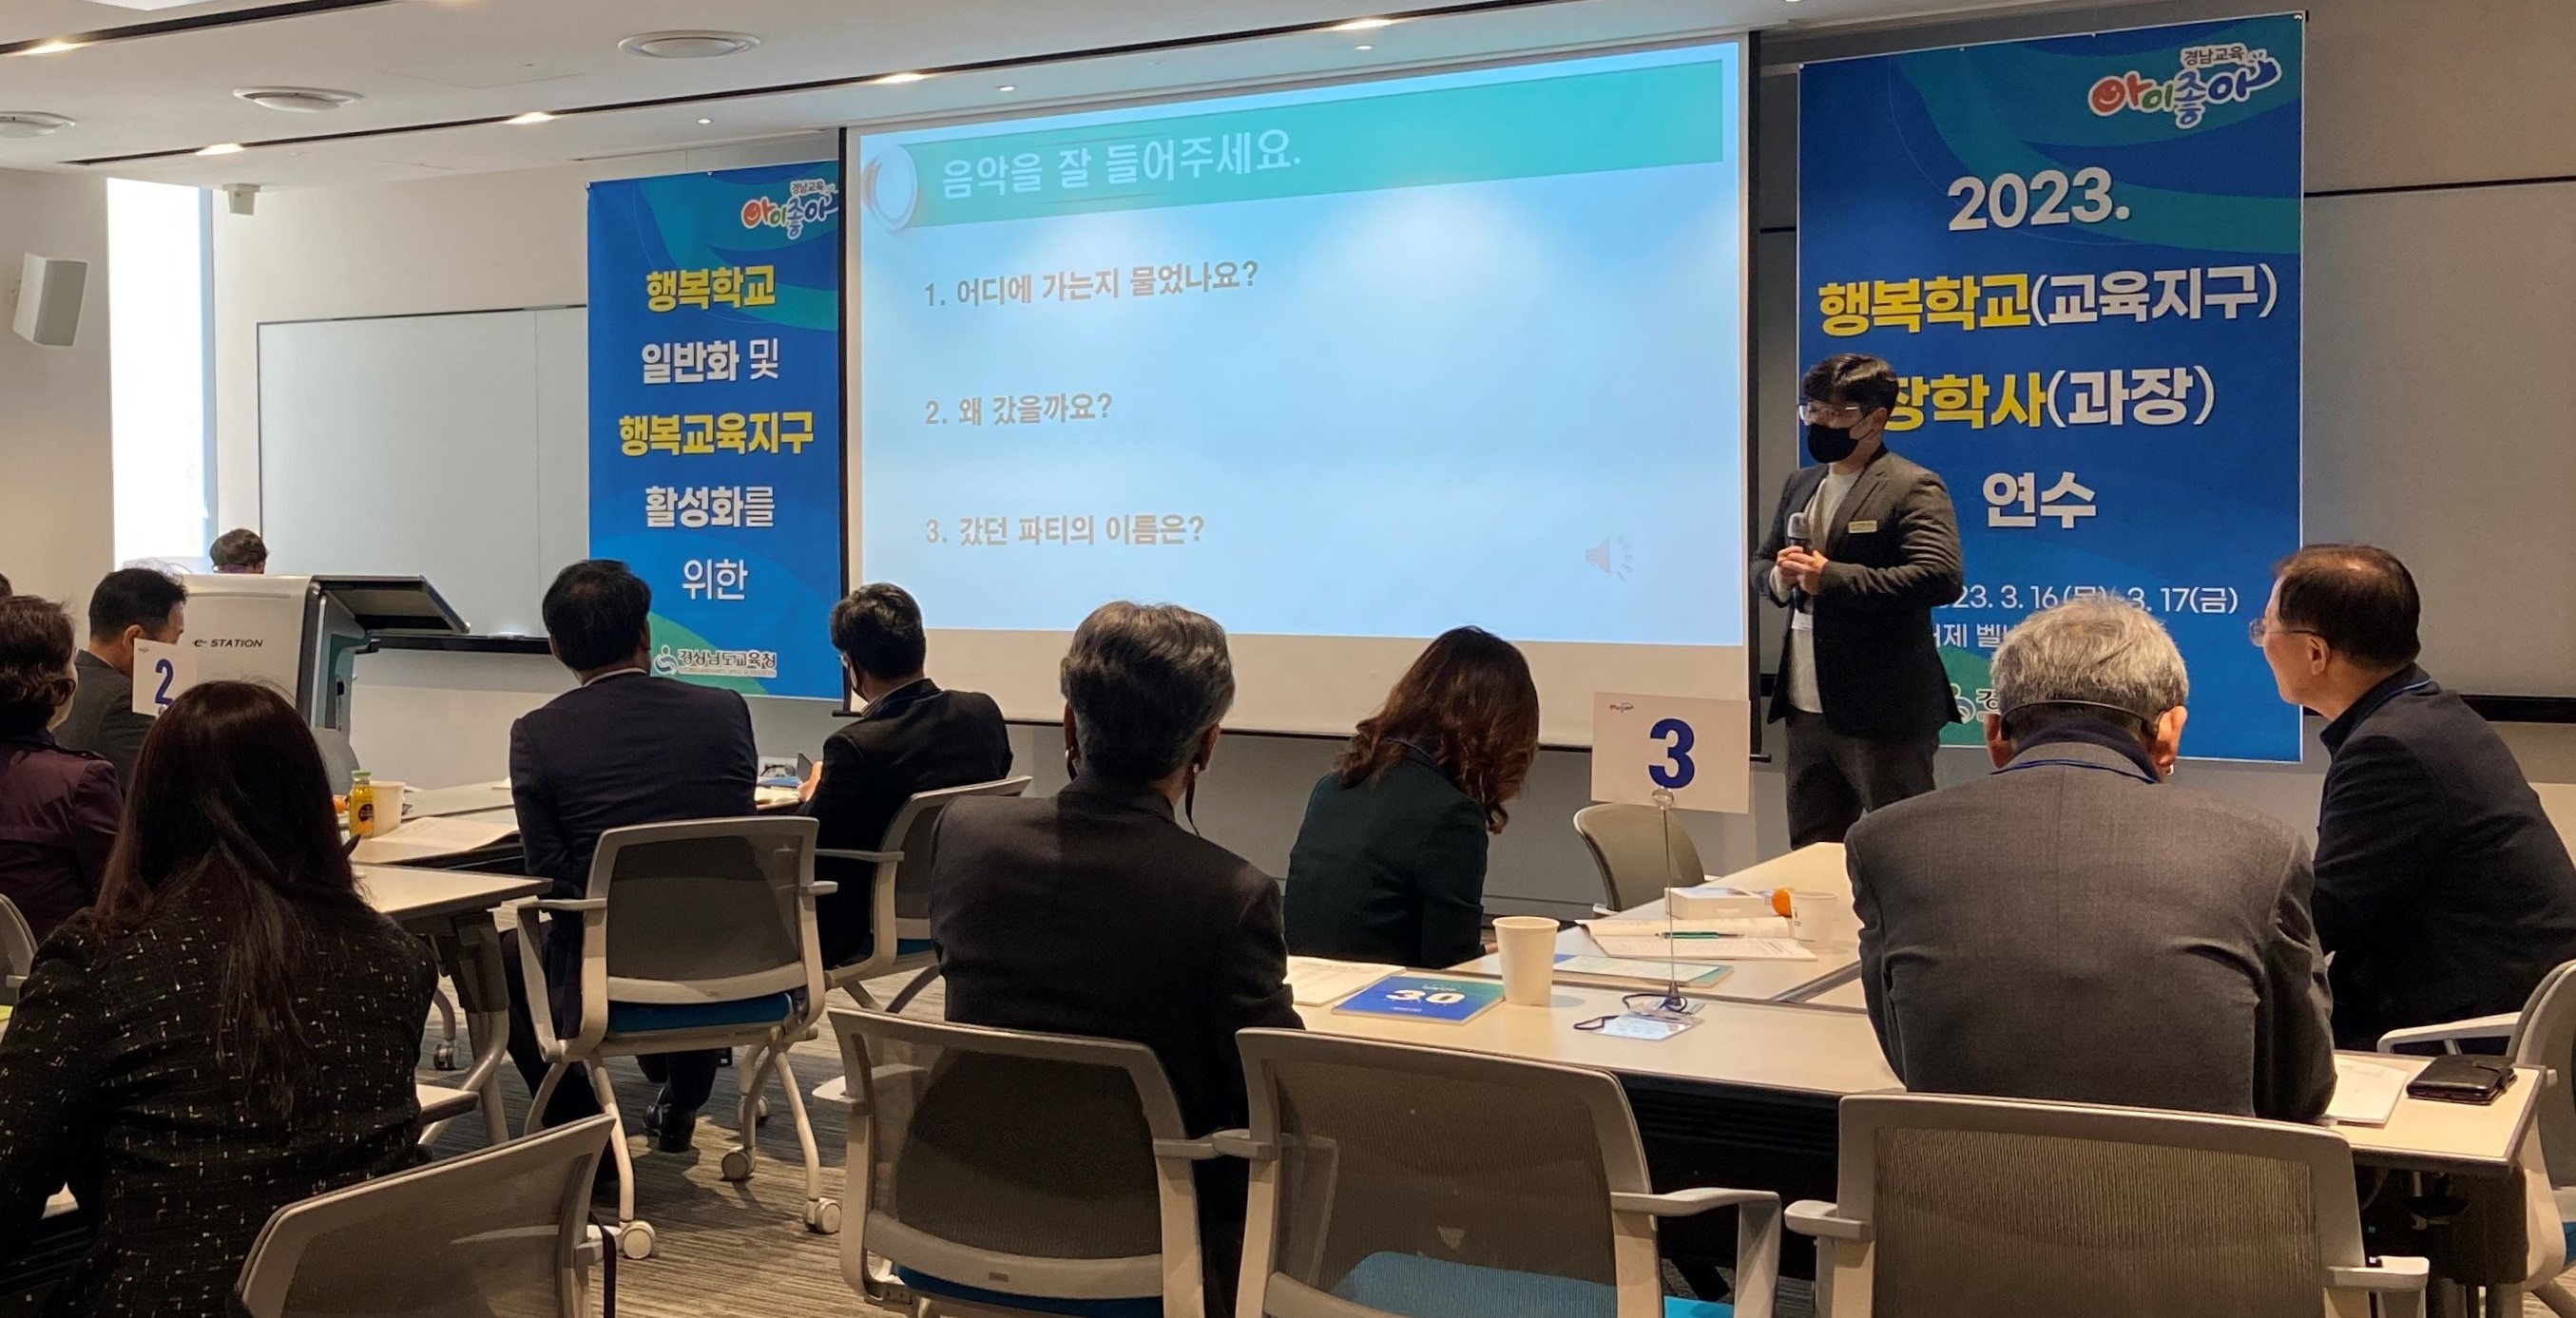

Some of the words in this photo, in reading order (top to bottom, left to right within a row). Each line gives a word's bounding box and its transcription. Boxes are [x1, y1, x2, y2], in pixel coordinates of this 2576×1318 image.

[2183, 46, 2245, 67] 경남교육
[2090, 61, 2278, 126] 아이좋아
[942, 151, 1042, 200] 음악을
[1058, 147, 1091, 189] 잘
[1105, 127, 1301, 185] 들어주세요.
[792, 180, 824, 195] 경남교육
[1947, 166, 2130, 231] 2023.
[646, 265, 776, 312] 행복학교
[925, 282, 947, 307] 1.
[957, 276, 1032, 307] 어디에
[1043, 267, 1120, 301] 가는지
[1130, 260, 1259, 296] 물었나요?
[1817, 264, 2278, 337] 행복학교(교육지구)
[642, 339, 740, 384] 일반화
[749, 338, 779, 380] 및
[925, 400, 948, 425] 2.
[958, 396, 983, 426] 왜
[992, 392, 1113, 426] 갔을까요?
[619, 411, 813, 456] 행복교육지구
[644, 486, 775, 527] 활성화를
[1982, 471, 2097, 529] 연수
[926, 519, 948, 544] 3.
[959, 516, 1008, 545] 갔던
[1018, 515, 1095, 545] 파티의
[1106, 515, 1205, 545] 이름은?
[682, 559, 748, 601] 위한
[1935, 584, 1993, 608] 23.
[2000, 584, 2024, 608] 3.
[2160, 585, 2239, 614] 17(금)
[210, 639, 263, 647] STATION
[678, 649, 777, 669] 경상남도교육청
[155, 659, 174, 705] 2
[1648, 718, 1695, 789] 3
